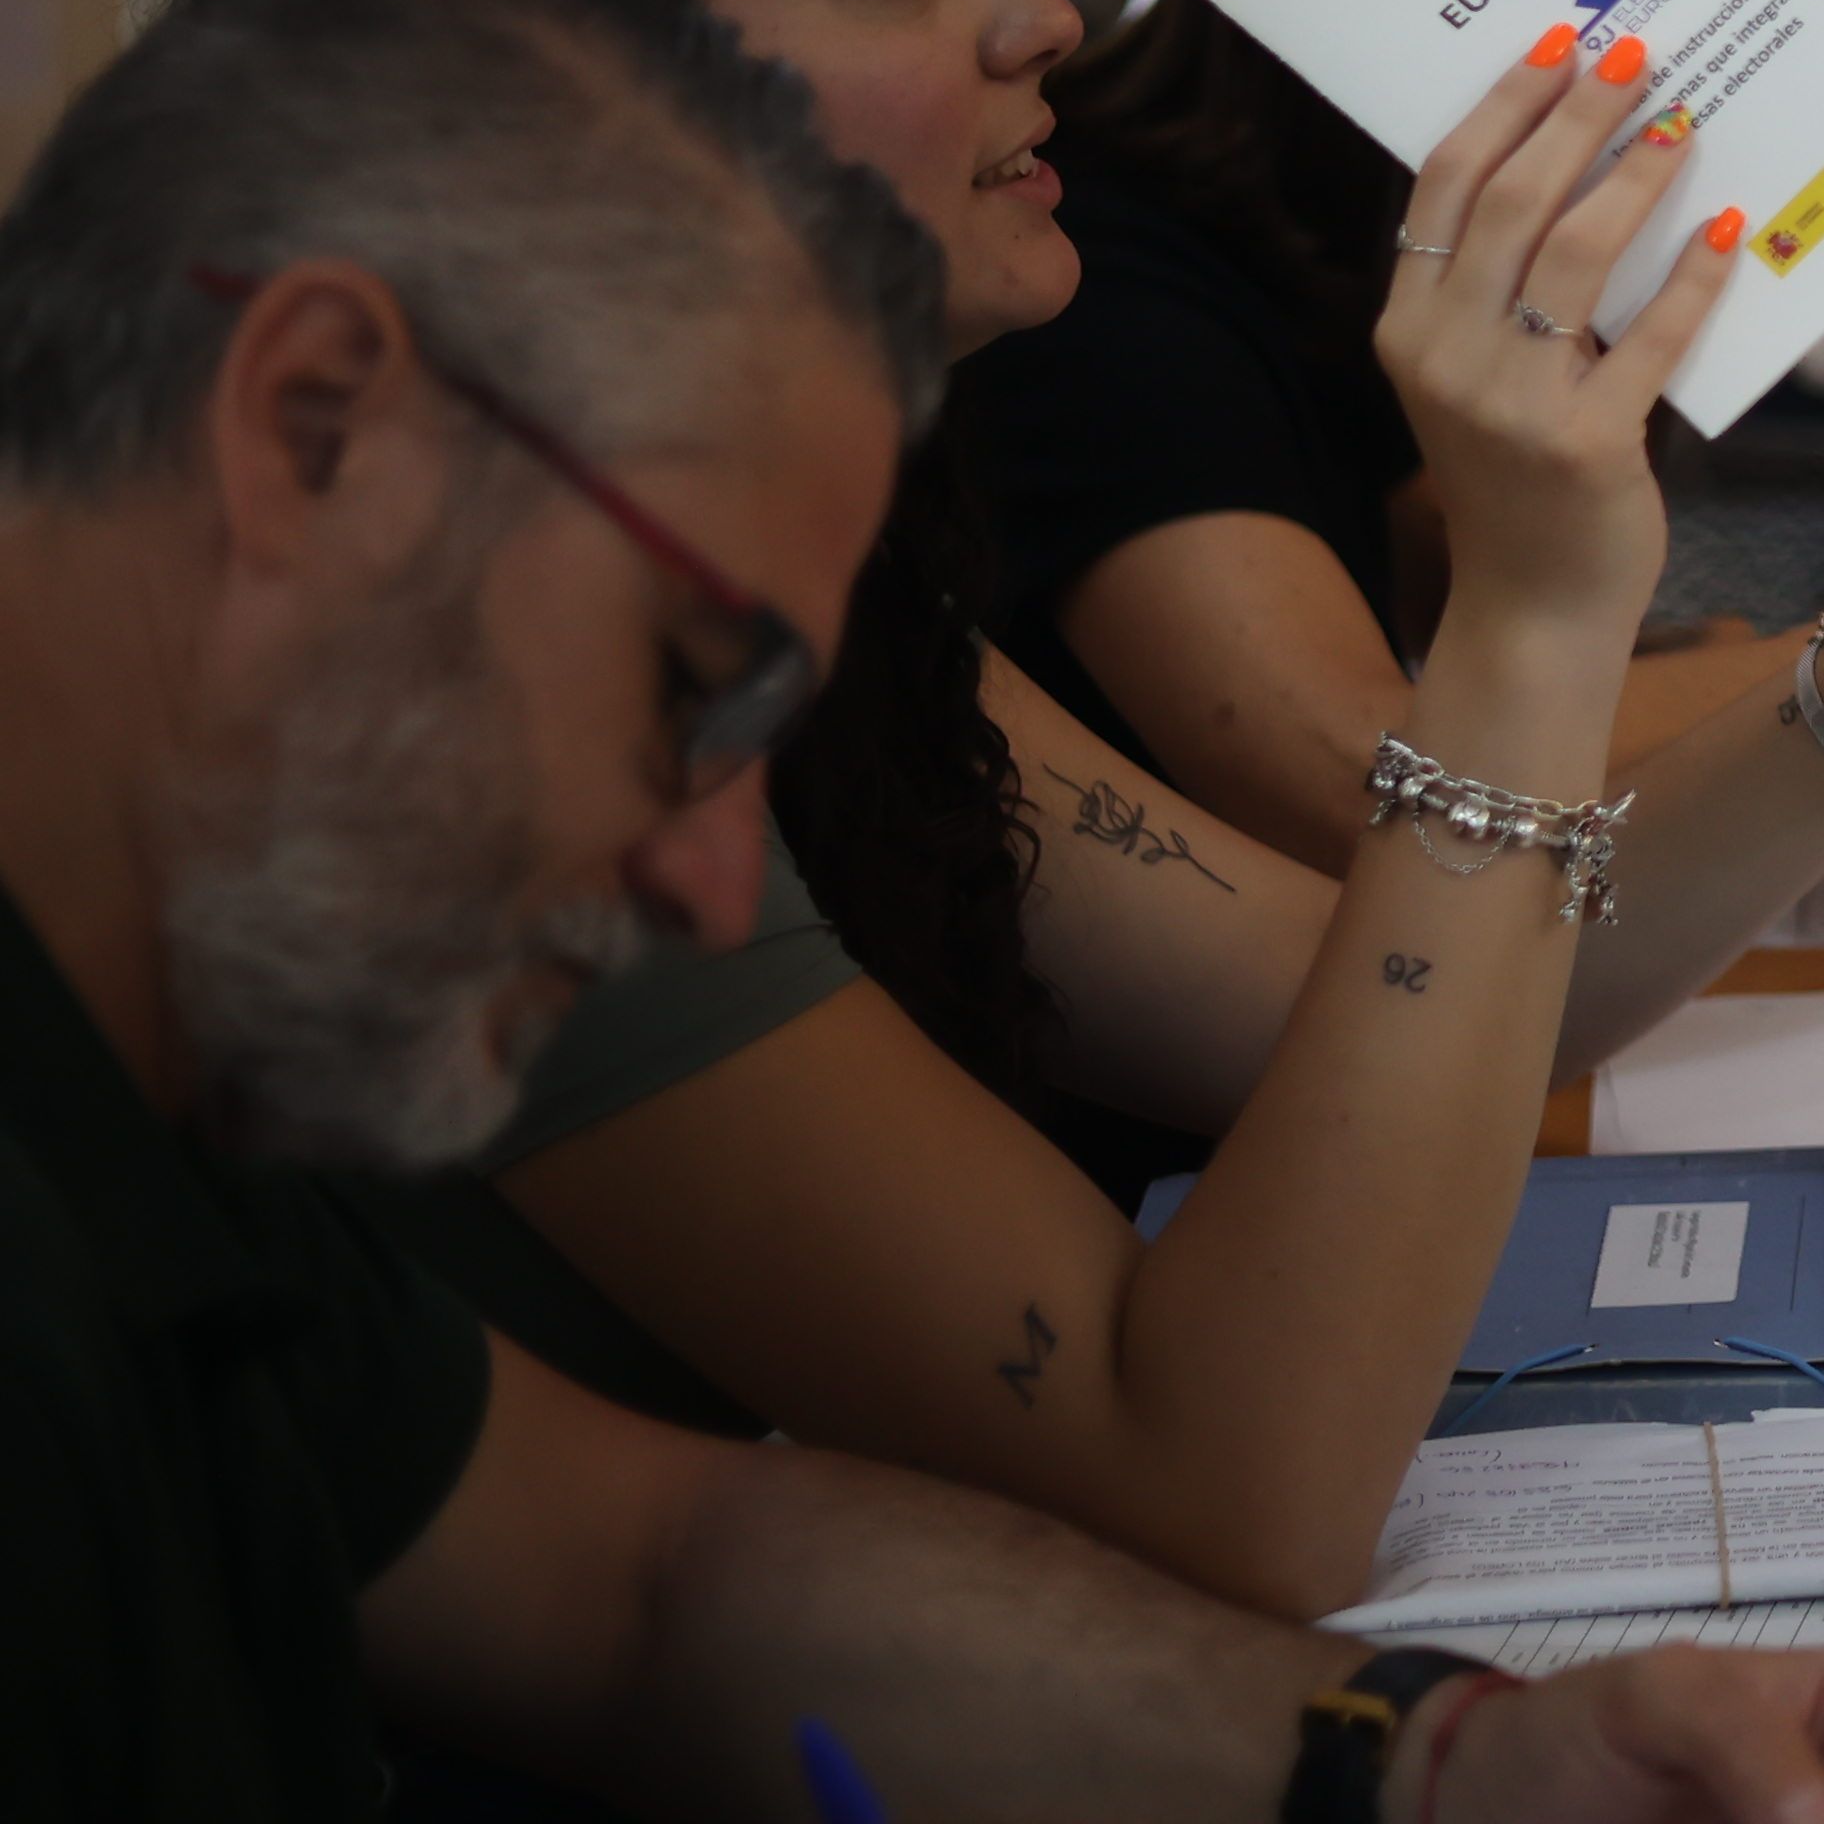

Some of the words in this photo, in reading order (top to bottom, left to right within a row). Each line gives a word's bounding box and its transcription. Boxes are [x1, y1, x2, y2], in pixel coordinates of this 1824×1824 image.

[1586, 25, 1616, 52] 9J
[1706, 42, 1738, 73] que
[1724, 16, 1805, 97] electorales
[1650, 65, 1673, 88] de
